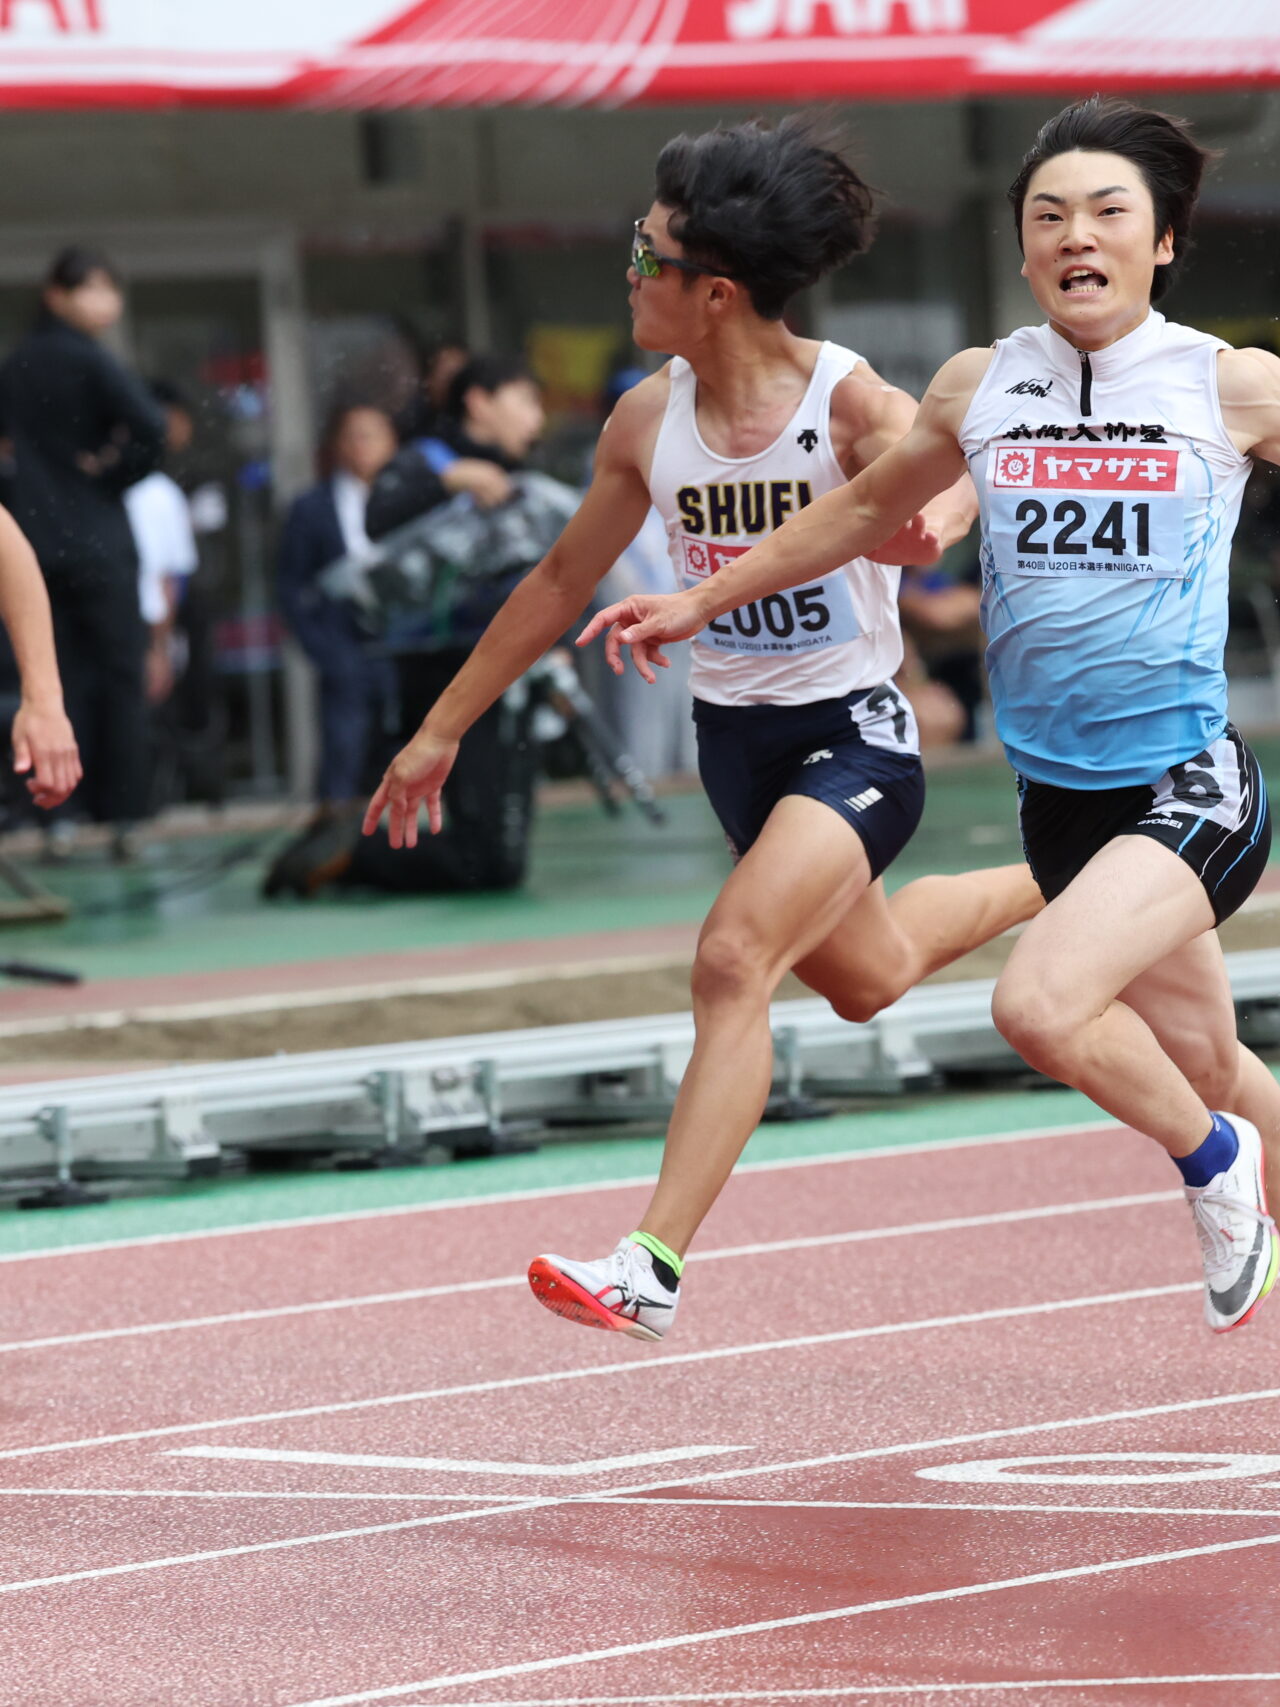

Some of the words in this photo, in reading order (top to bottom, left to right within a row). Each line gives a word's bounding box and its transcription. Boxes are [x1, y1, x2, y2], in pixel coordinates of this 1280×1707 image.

[1042, 455, 1168, 482] ヤマザキ
[1015, 498, 1150, 556] 2241
[1017, 560, 1046, 571] 第40回
[867, 683, 907, 744] 7
[1168, 749, 1224, 808] 6
